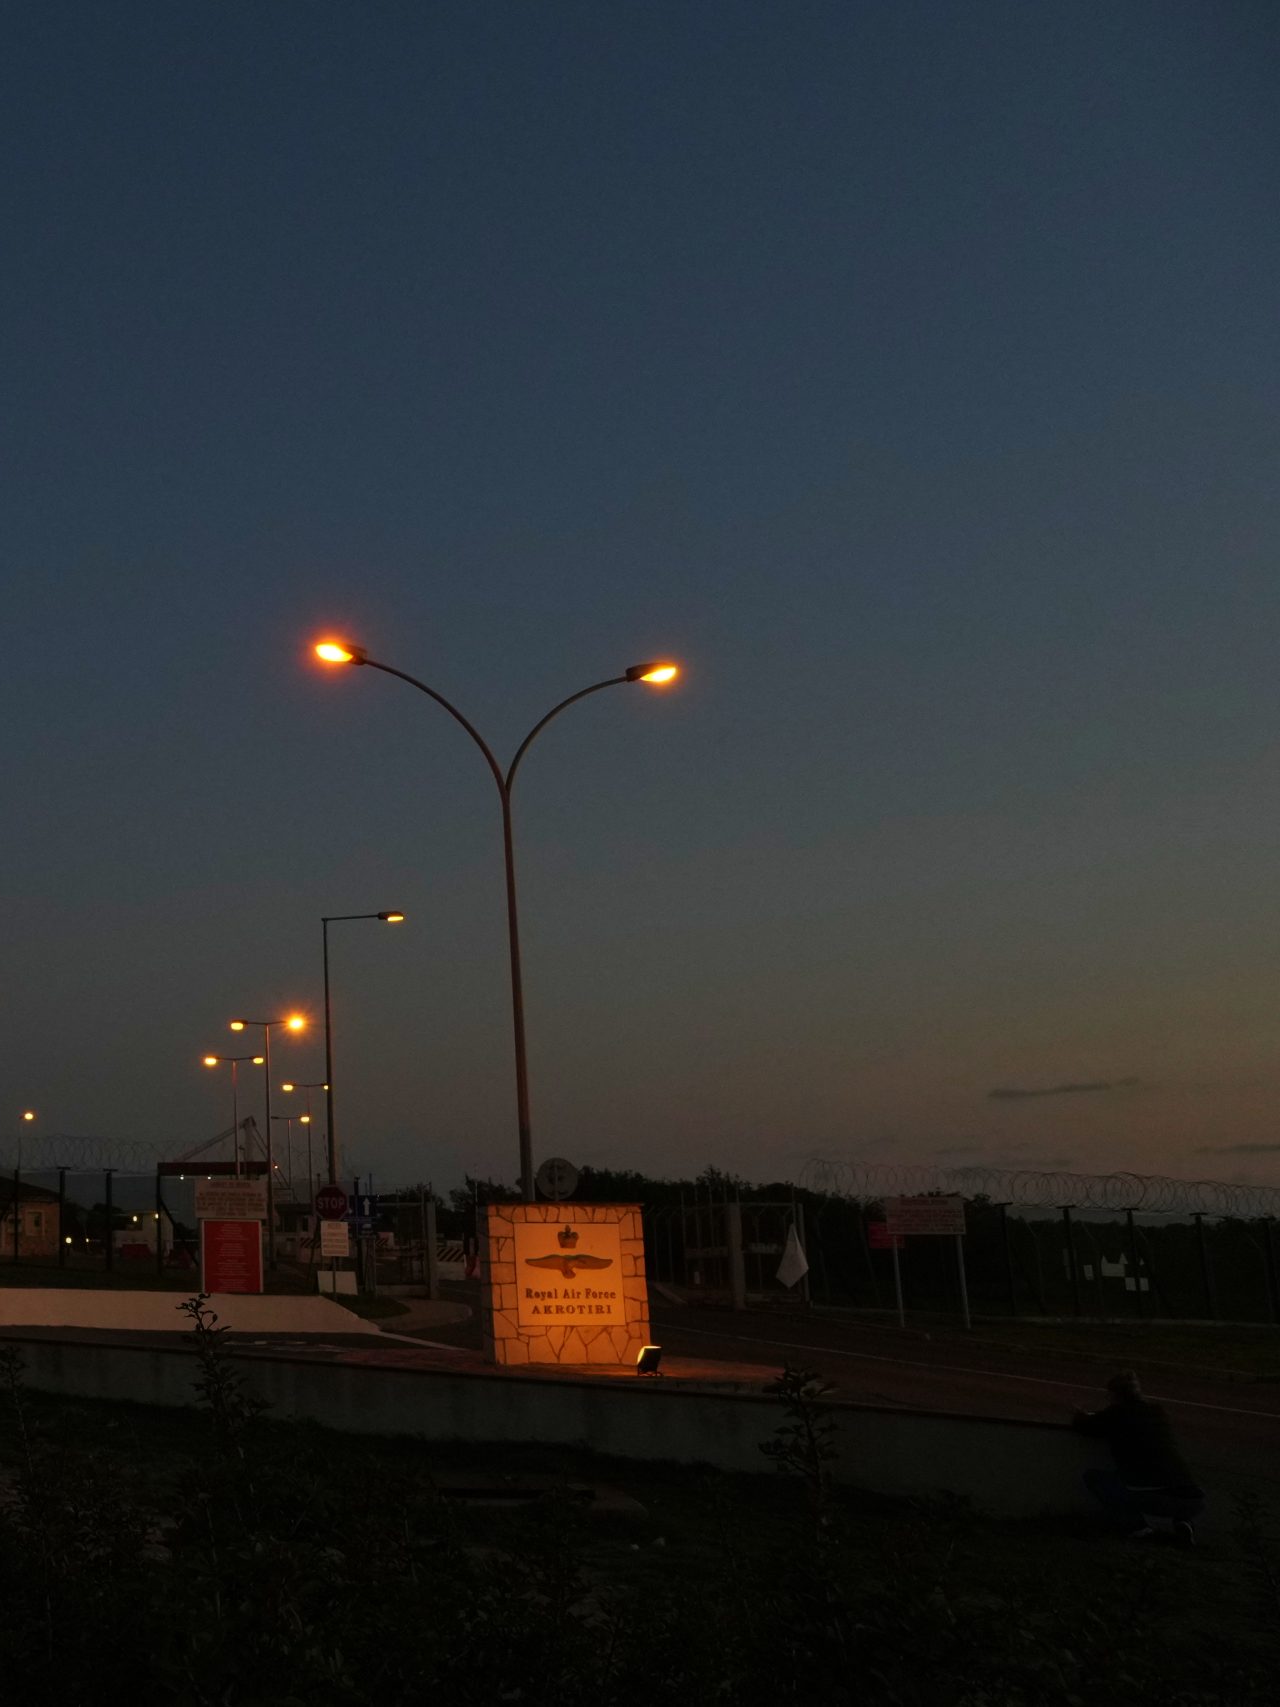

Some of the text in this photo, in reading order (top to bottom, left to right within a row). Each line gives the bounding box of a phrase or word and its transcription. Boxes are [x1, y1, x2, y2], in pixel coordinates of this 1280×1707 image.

[318, 1196, 345, 1209] STOP
[525, 1287, 617, 1301] Royal Air Force
[531, 1304, 612, 1315] AKROTIRI
